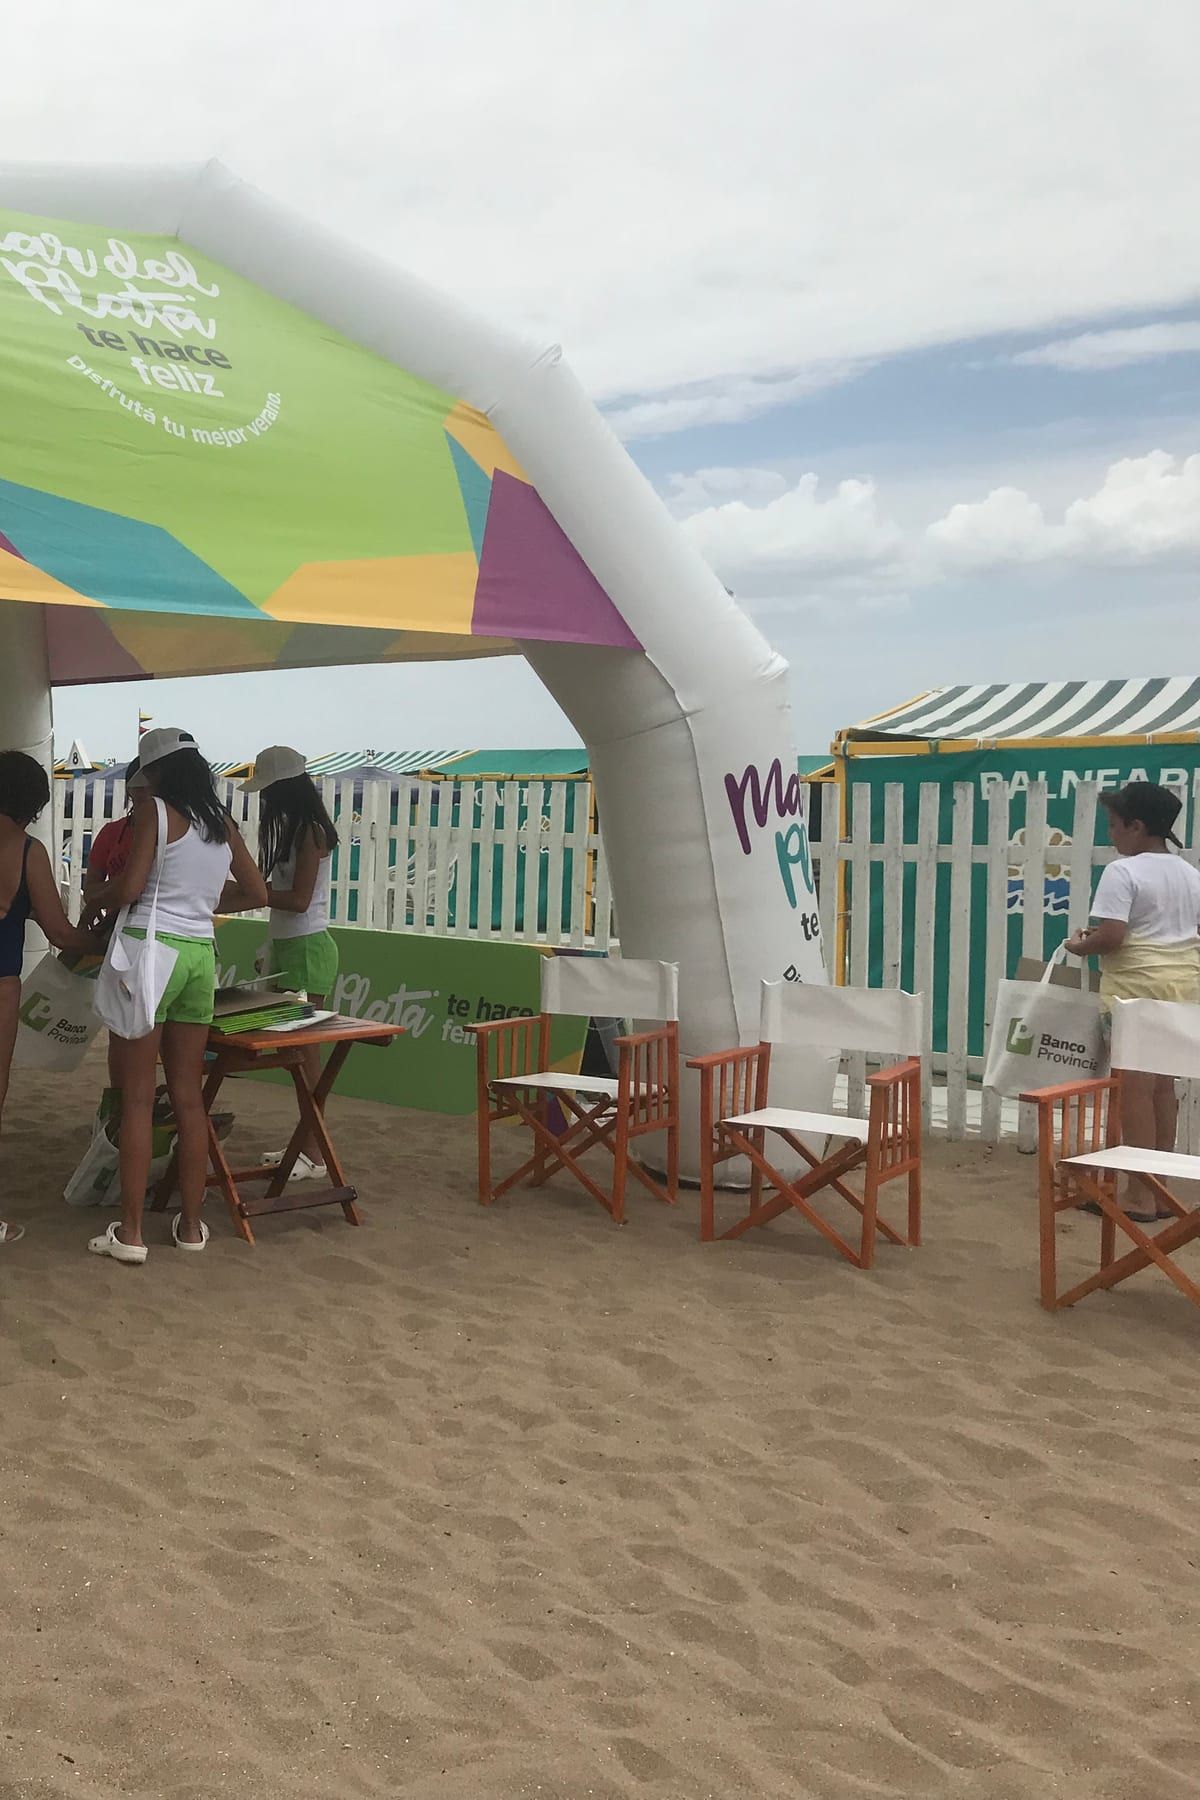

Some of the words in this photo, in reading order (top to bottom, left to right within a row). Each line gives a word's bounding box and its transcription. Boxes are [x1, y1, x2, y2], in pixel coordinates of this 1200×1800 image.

[103, 239, 219, 297] del
[0, 257, 216, 339] Plata
[76, 322, 128, 352] te
[128, 330, 233, 369] hace
[130, 356, 225, 398] feliz
[66, 354, 156, 425] Disfrutá
[162, 415, 186, 439] tu
[191, 426, 249, 448] mejor
[72, 751, 79, 765] 8
[724, 758, 804, 855] Ma
[801, 912, 819, 941] te
[447, 994, 470, 1017] te
[1037, 1046, 1099, 1072] Provincia
[1040, 1033, 1086, 1054] Banco
